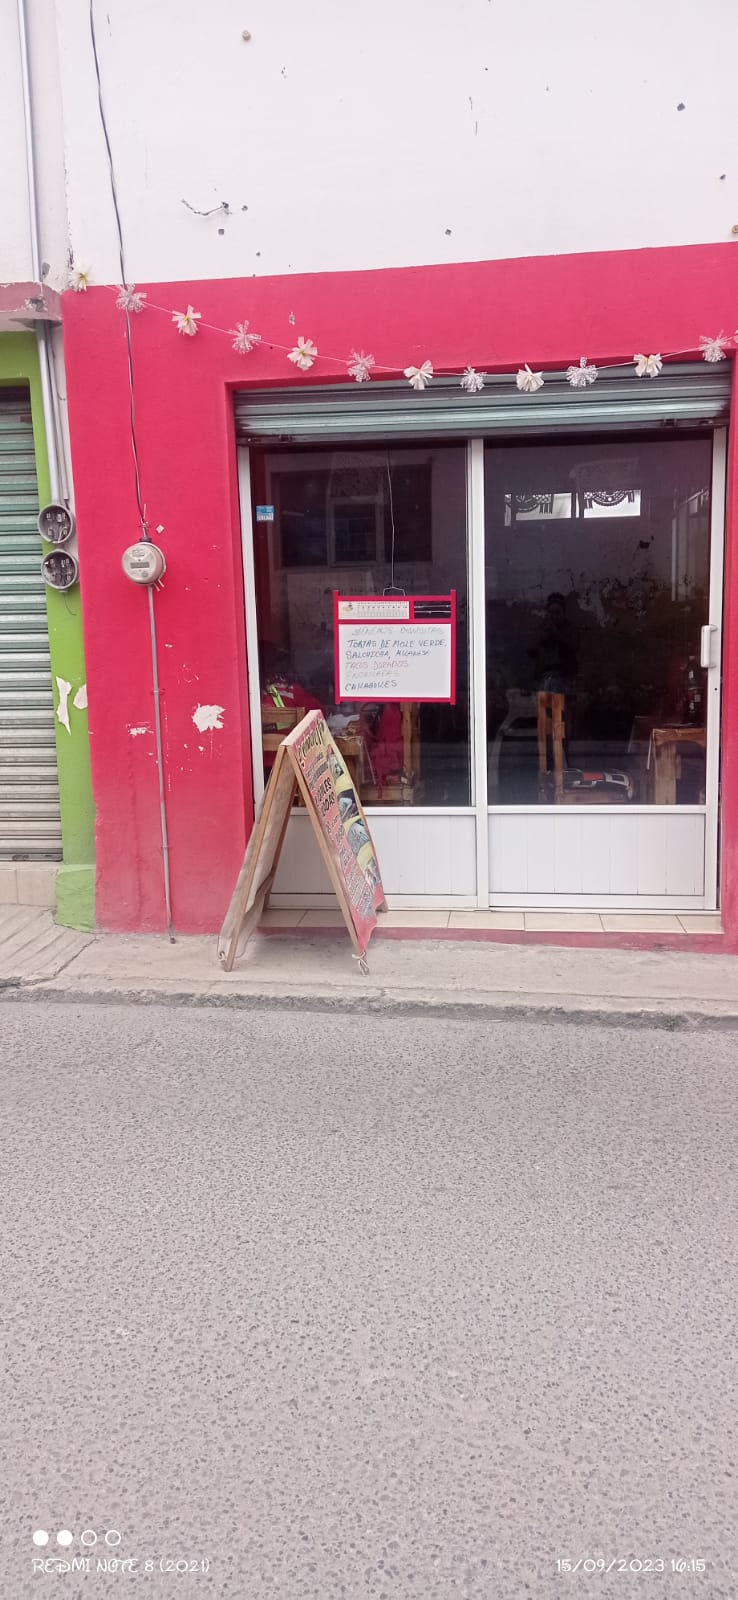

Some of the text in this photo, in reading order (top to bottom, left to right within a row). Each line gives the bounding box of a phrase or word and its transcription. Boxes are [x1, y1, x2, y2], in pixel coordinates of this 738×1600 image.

[347, 640, 376, 648] TORTAS
[379, 640, 391, 649] DE
[393, 640, 415, 648] MOLE
[345, 662, 369, 670] TACOS
